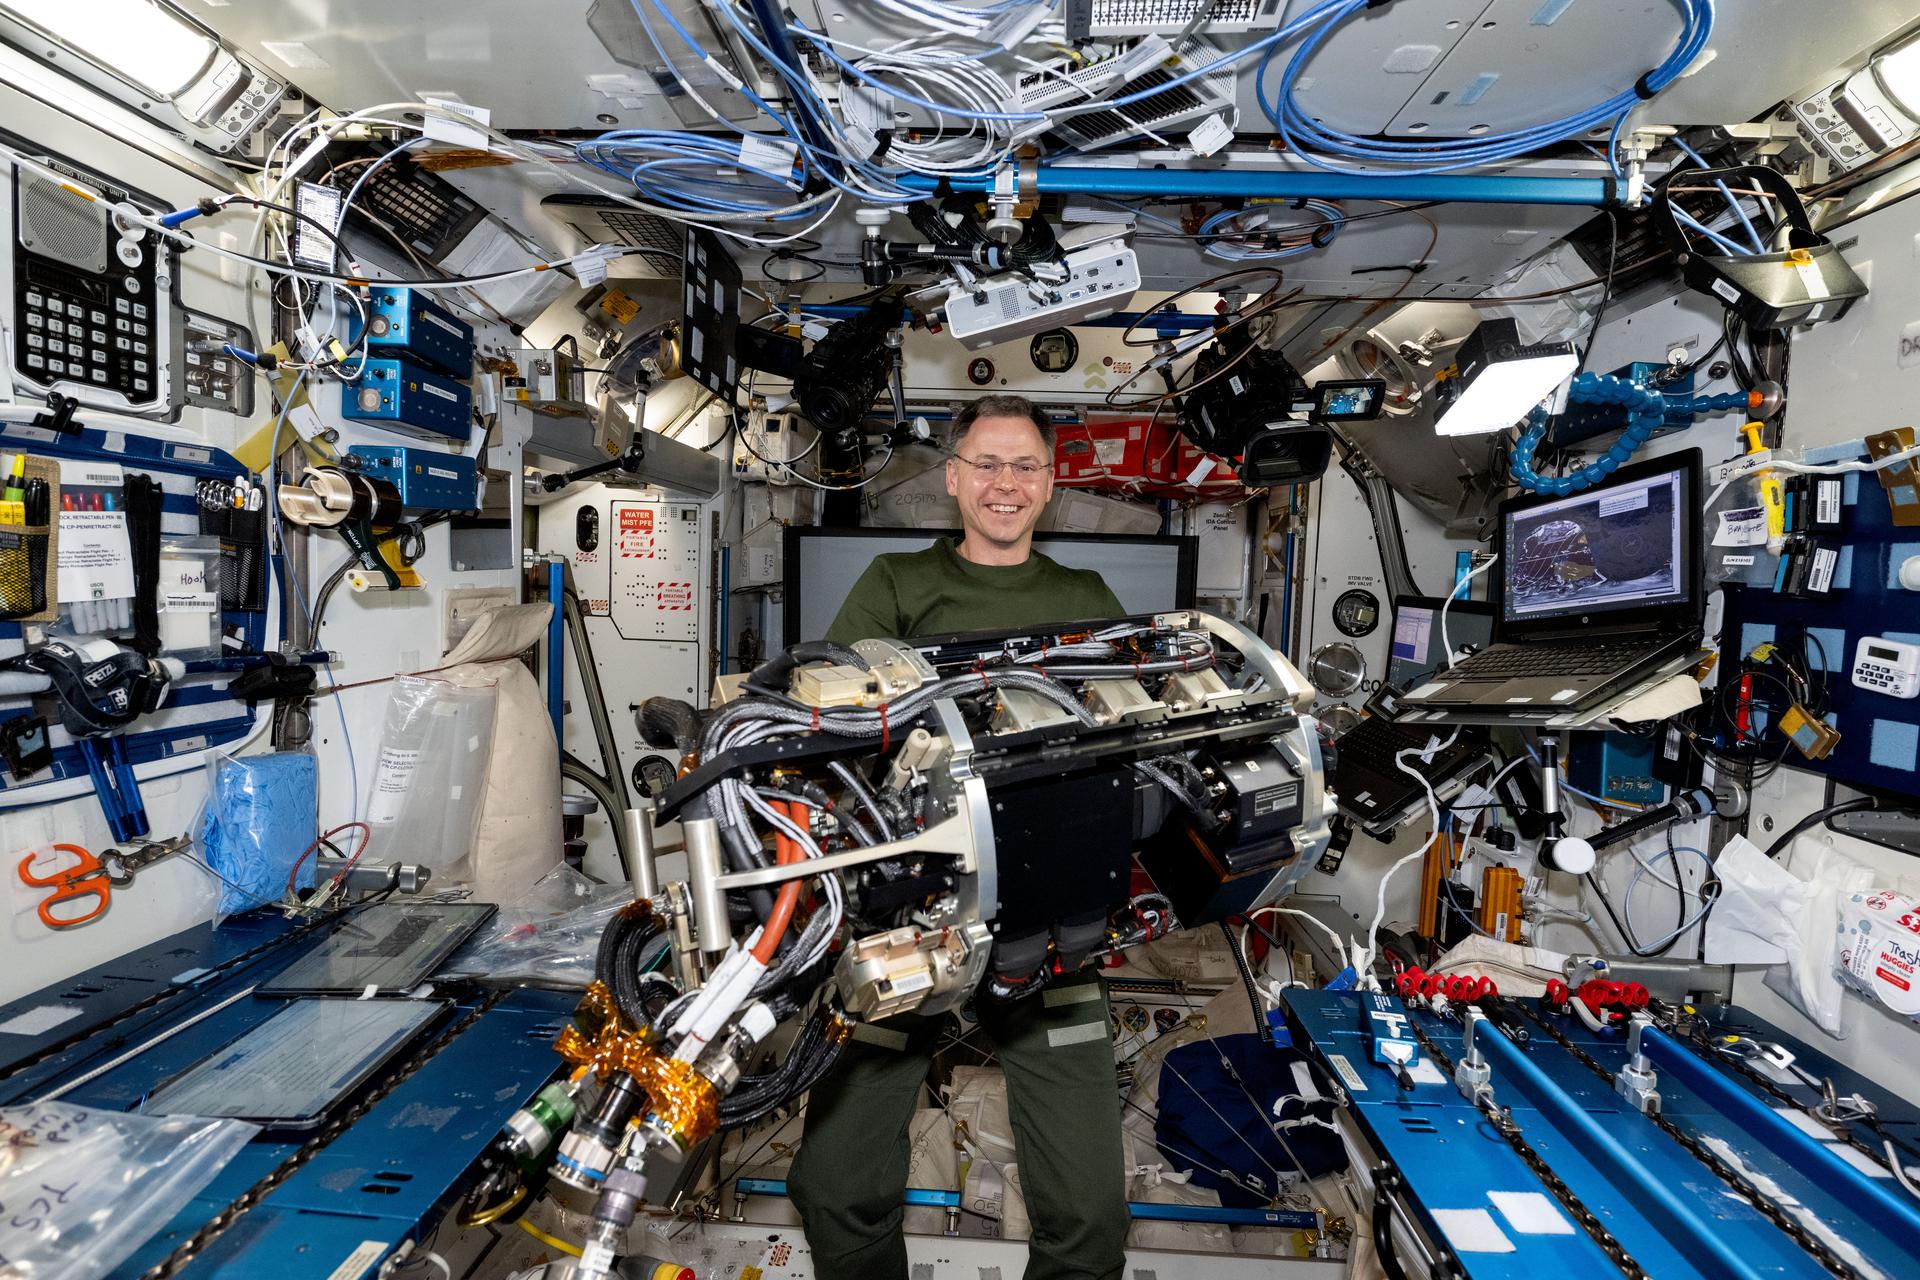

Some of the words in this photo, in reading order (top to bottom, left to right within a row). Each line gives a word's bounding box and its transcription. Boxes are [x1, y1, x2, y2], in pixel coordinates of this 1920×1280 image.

[54, 164, 74, 177] AUDIO
[77, 173, 107, 192] TERMINAL
[109, 188, 123, 198] UNIT
[128, 281, 138, 289] PTT
[624, 511, 650, 519] WATER
[348, 529, 362, 549] KAPTON
[181, 571, 207, 585] Hook
[84, 664, 117, 687] PETZL
[1880, 952, 1915, 973] HUGGIES
